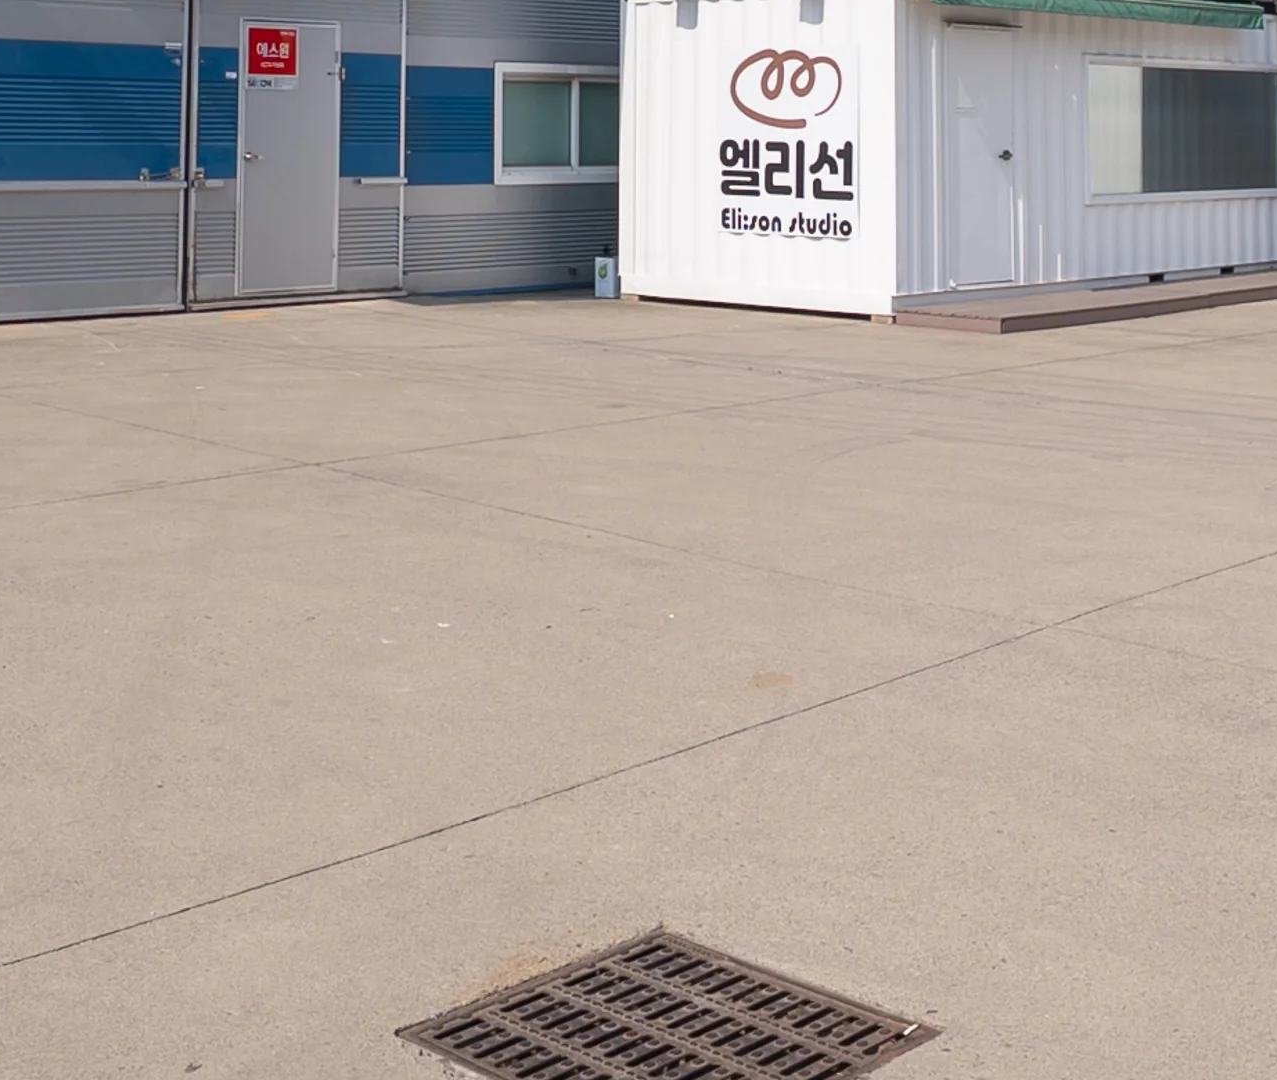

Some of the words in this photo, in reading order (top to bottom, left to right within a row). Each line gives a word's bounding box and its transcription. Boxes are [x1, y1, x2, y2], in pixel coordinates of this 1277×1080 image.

[256, 41, 290, 59] 에스원
[719, 138, 854, 201] 엘리선
[789, 211, 852, 237] studio
